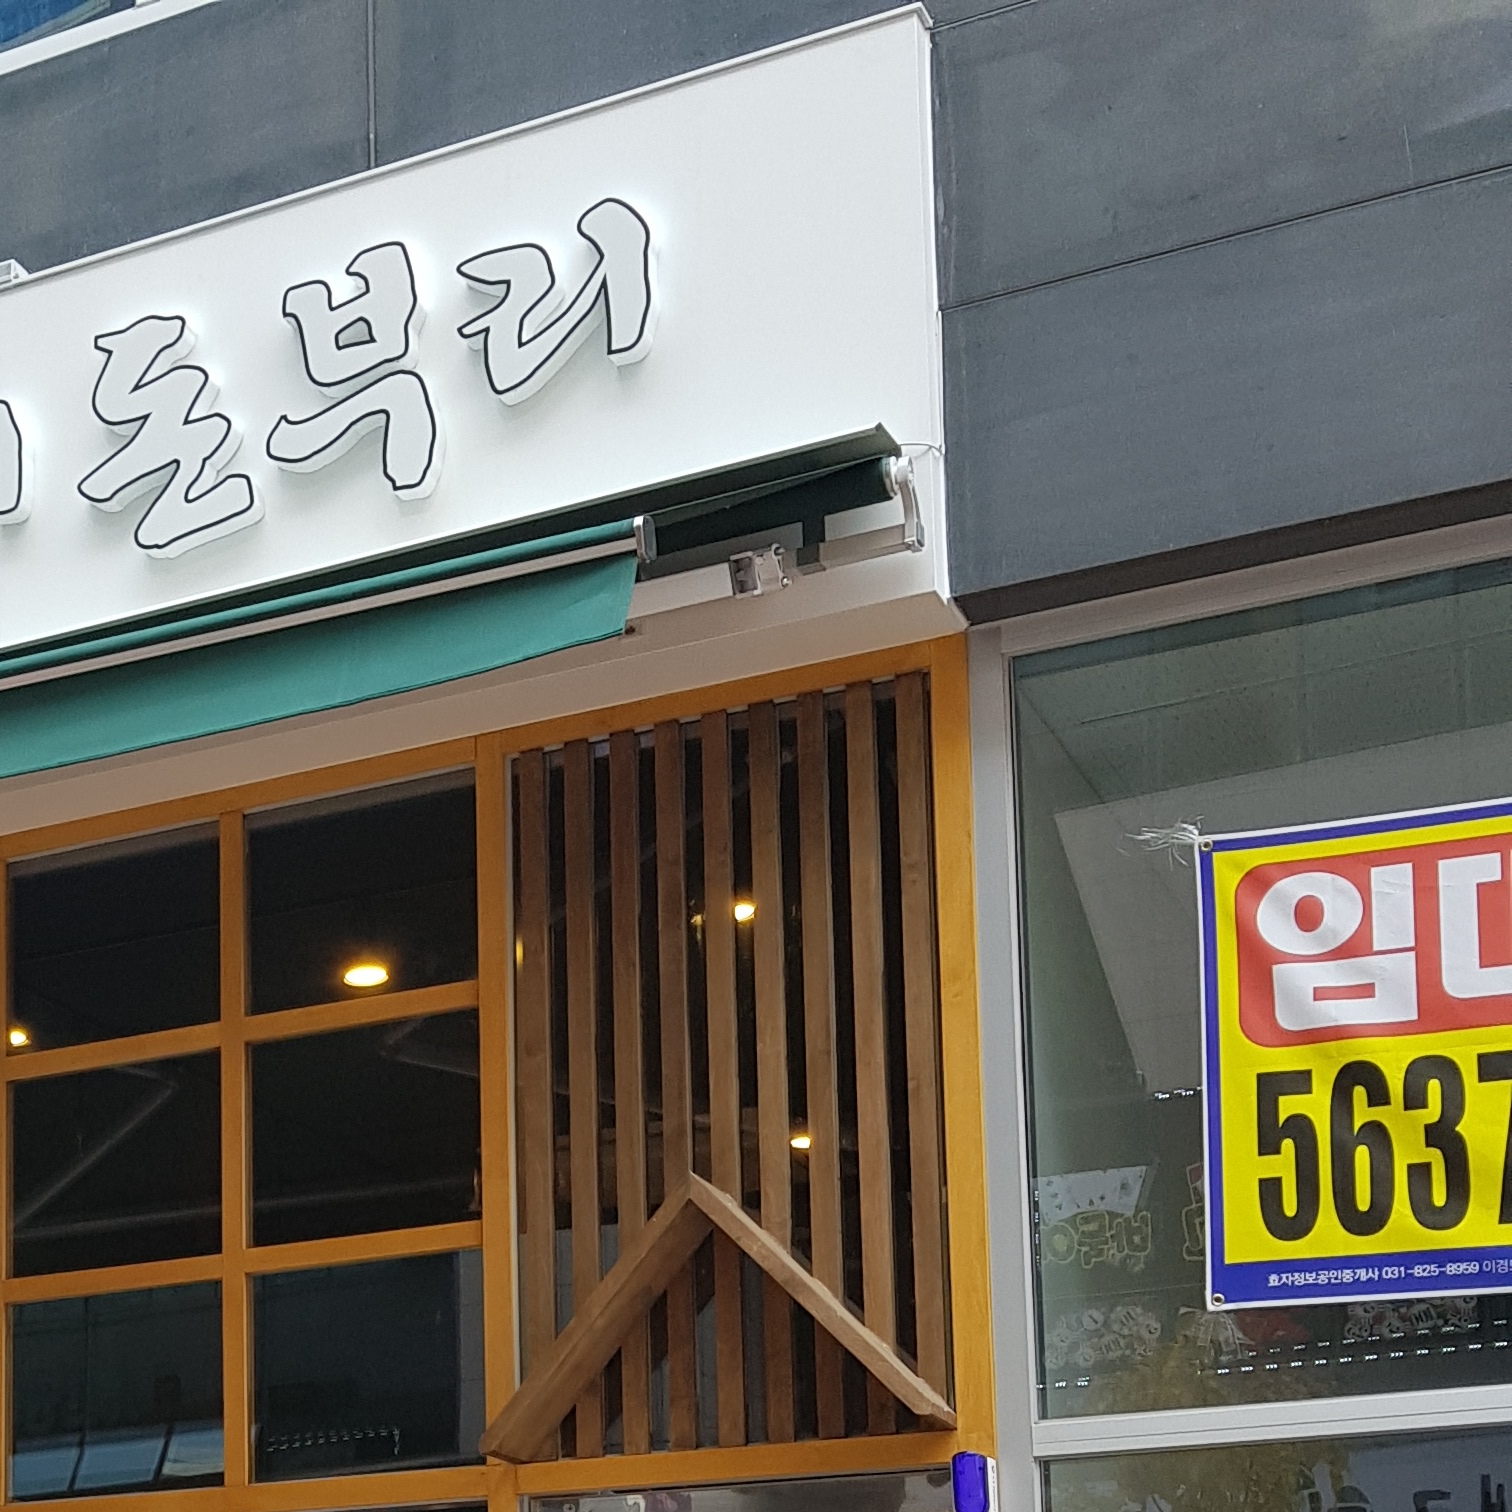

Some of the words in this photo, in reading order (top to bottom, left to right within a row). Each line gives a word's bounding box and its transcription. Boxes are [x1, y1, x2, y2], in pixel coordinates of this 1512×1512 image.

[77, 197, 651, 552] 돈부리
[1268, 1267, 1379, 1288] 효자정보공인중개사
[1382, 1261, 1479, 1280] 031-825-8959
